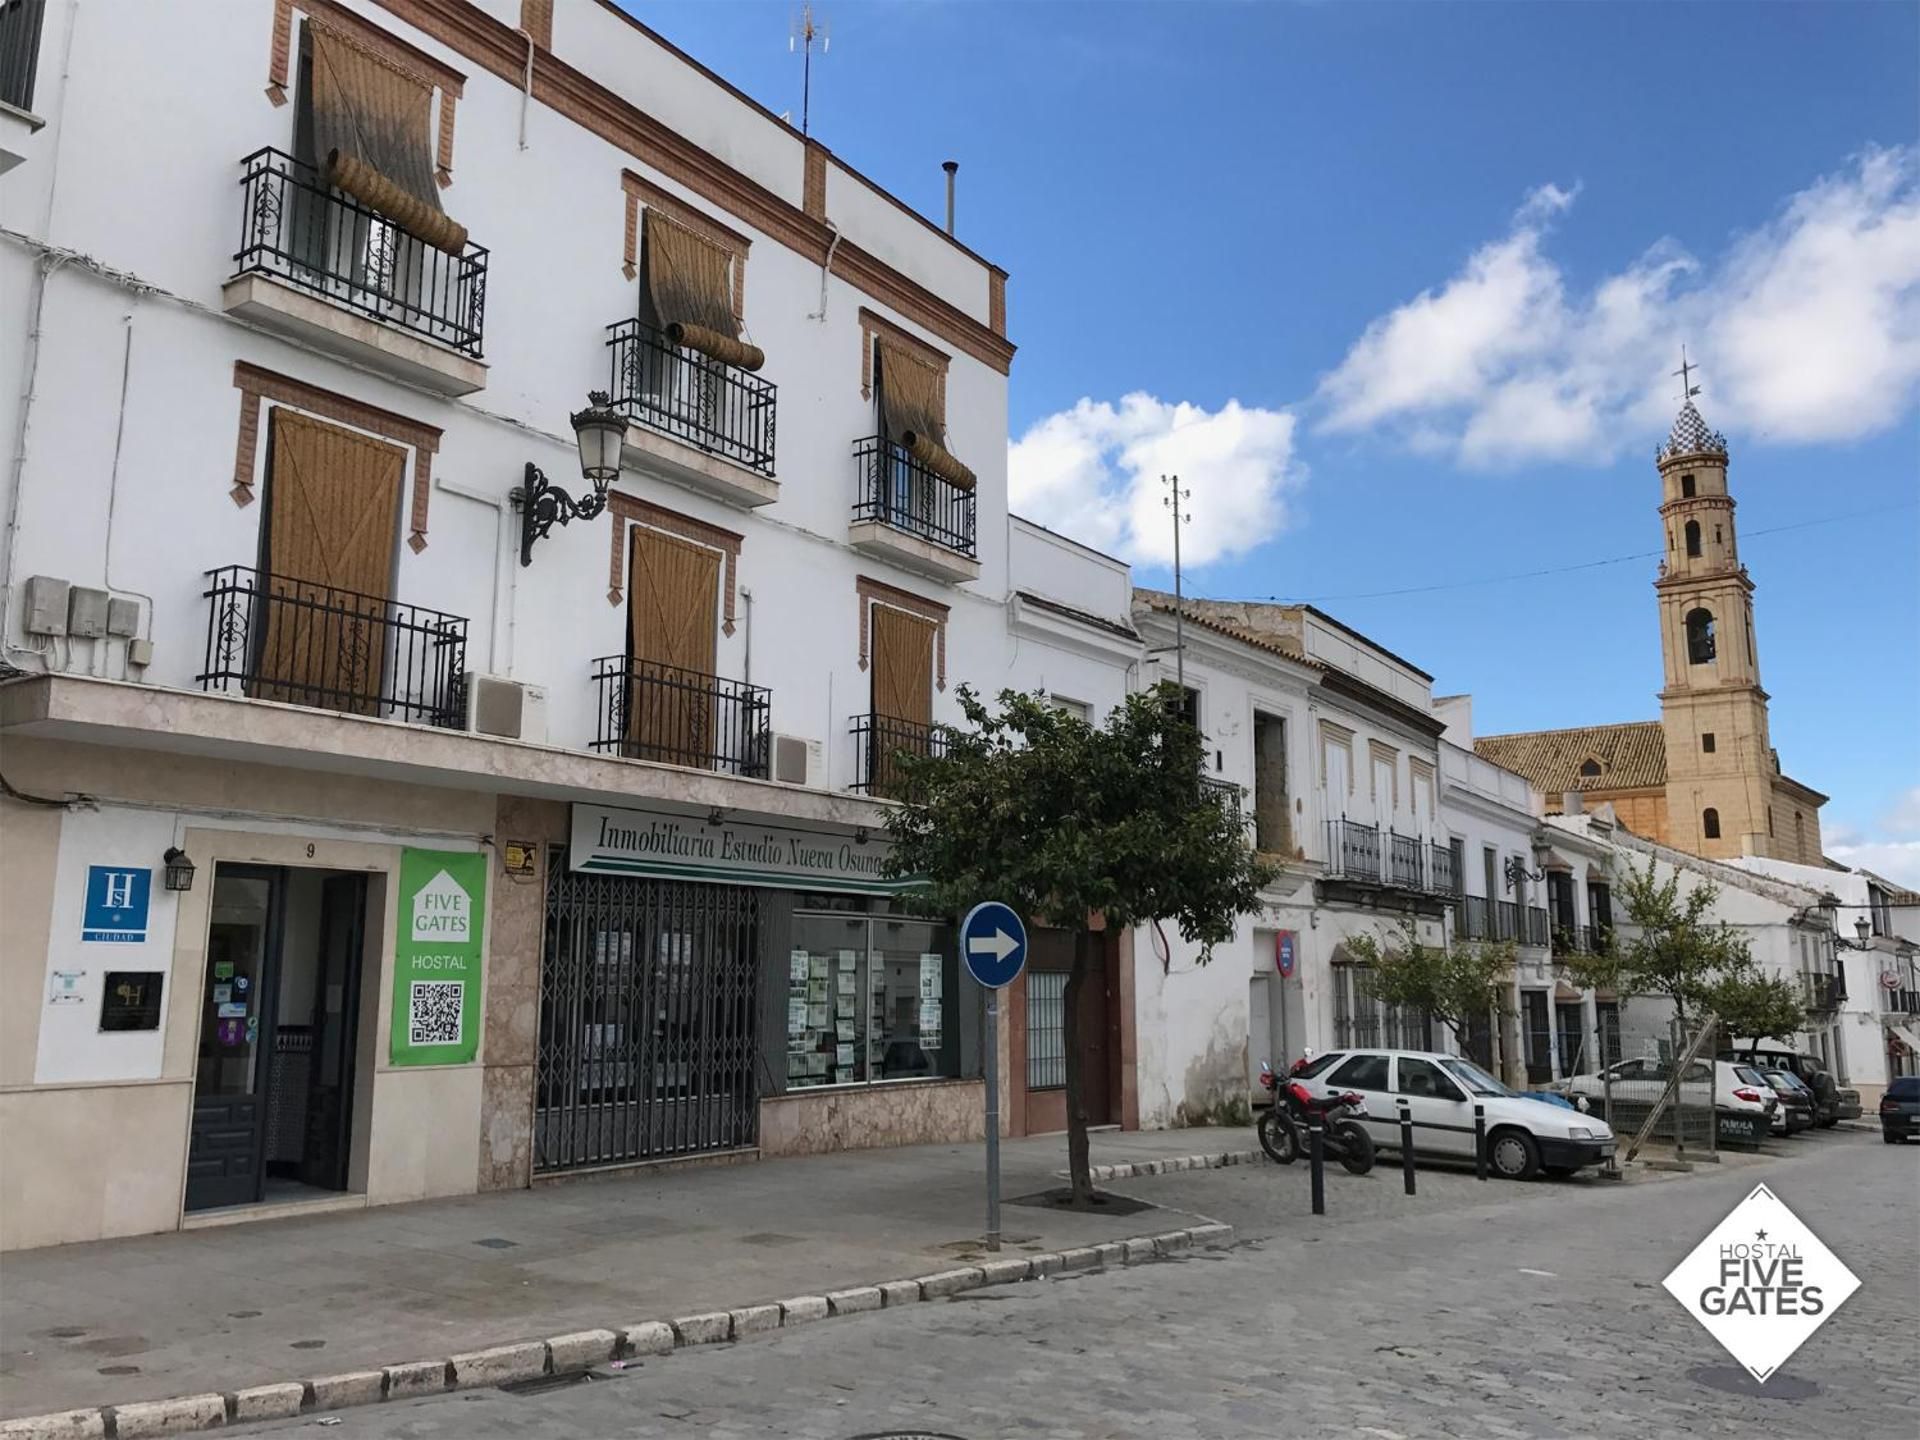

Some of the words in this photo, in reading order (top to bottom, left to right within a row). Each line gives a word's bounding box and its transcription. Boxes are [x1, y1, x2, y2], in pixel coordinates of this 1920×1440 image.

[306, 842, 316, 859] 9
[597, 816, 714, 858] Inmobiliaria
[720, 831, 782, 865] Estudio
[786, 838, 833, 870] Nueva
[838, 843, 882, 874] Osuna
[424, 893, 462, 911] FIVE
[415, 914, 467, 932] GATES
[412, 954, 467, 970] HOSTAL
